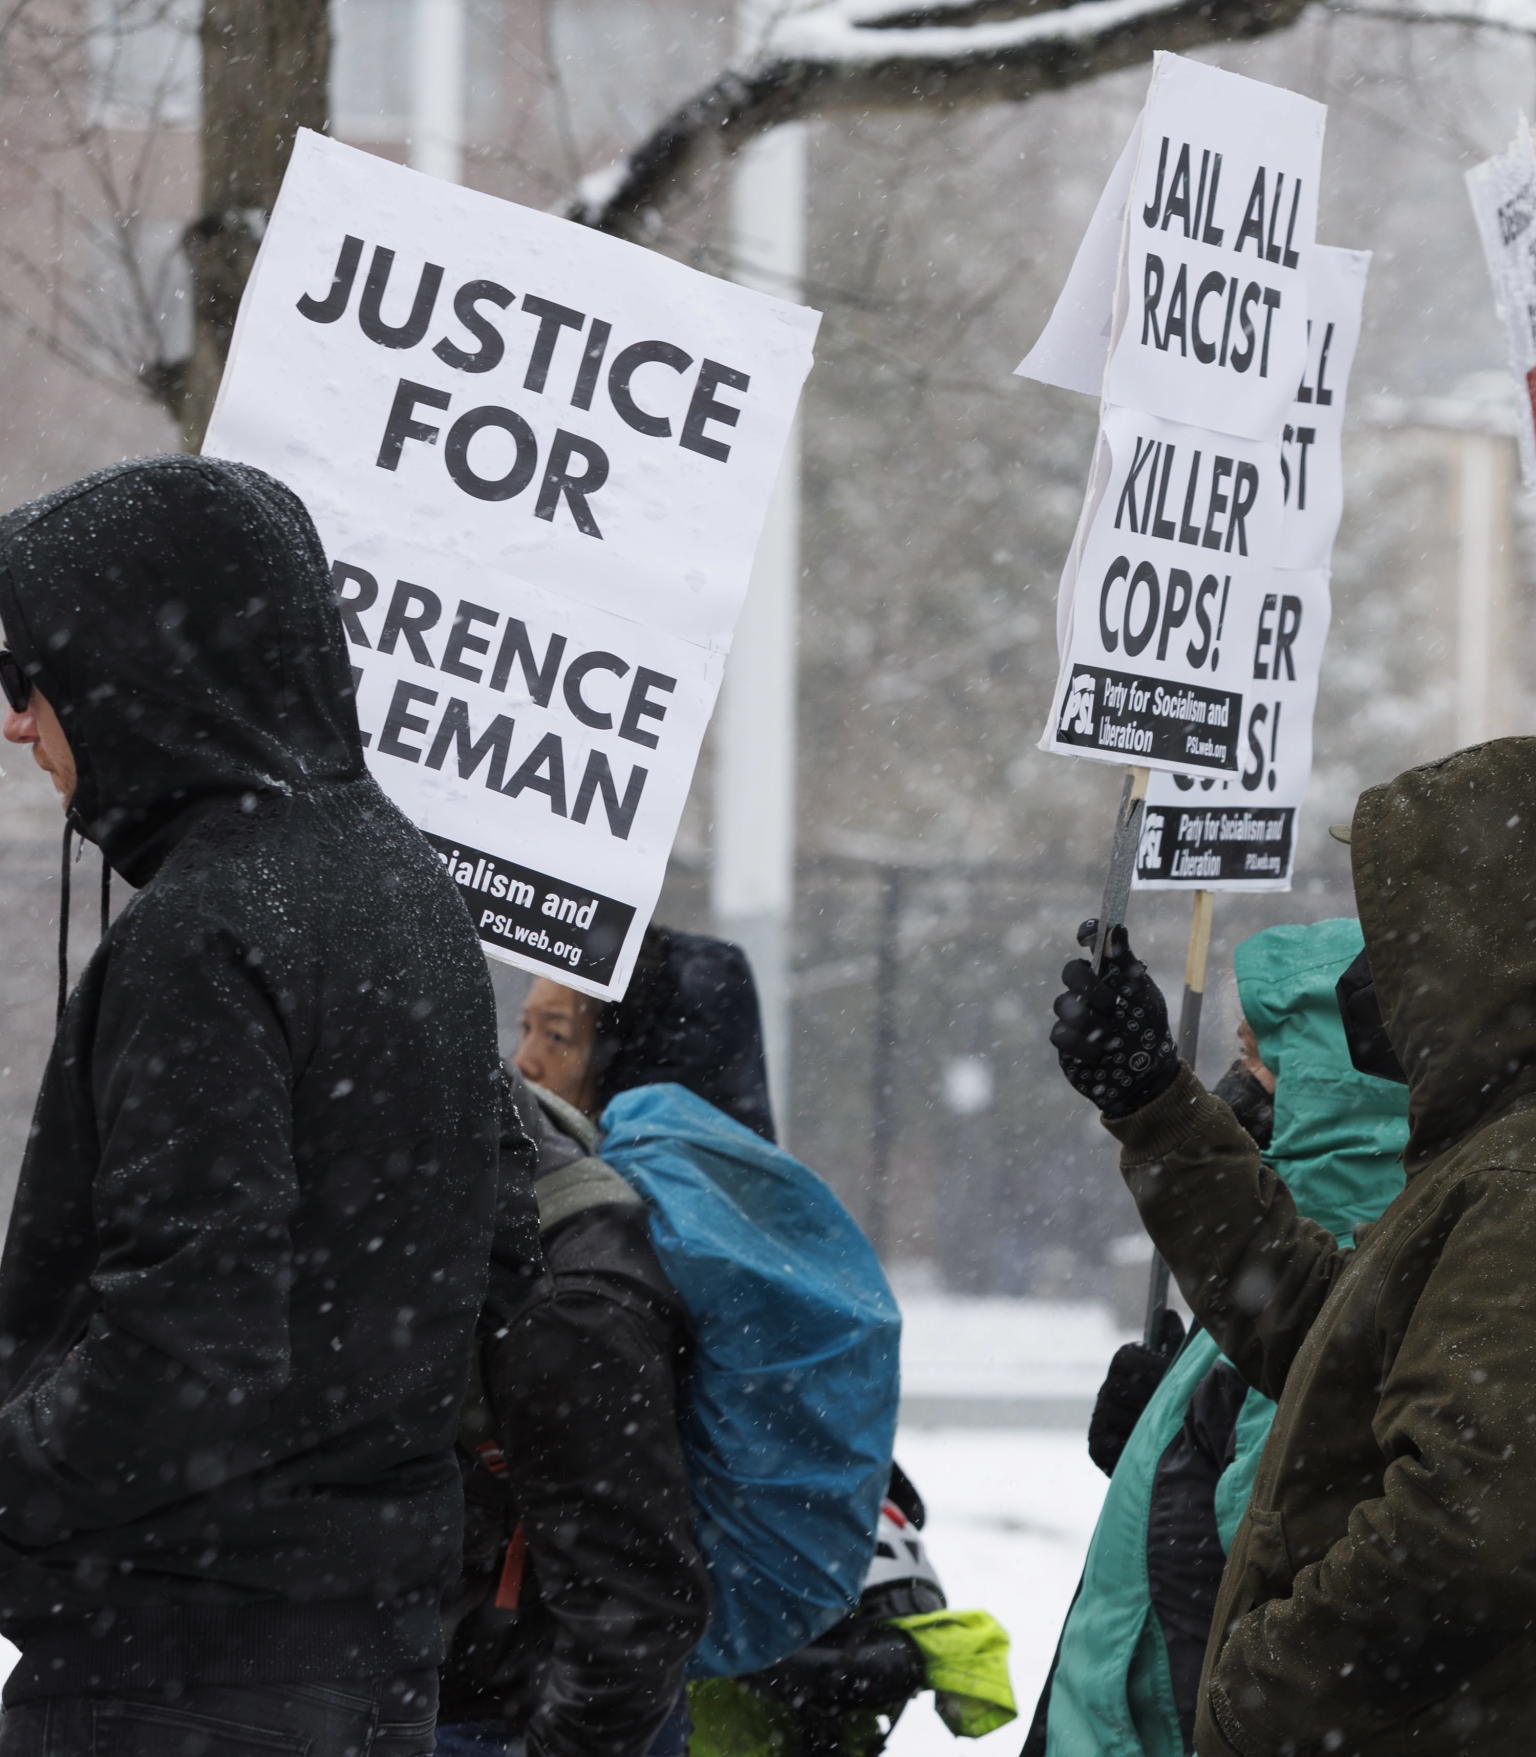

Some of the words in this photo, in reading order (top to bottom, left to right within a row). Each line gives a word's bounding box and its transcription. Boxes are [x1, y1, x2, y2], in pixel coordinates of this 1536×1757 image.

[1143, 136, 1224, 247] JAIL
[1234, 166, 1302, 269] ALL
[296, 234, 751, 463] JUSTICE
[1141, 253, 1281, 378] RACIST
[376, 378, 610, 541] FOR
[1114, 436, 1259, 557] KILLER
[1099, 555, 1231, 672] COPS!
[1098, 716, 1154, 753] Liberation
[1186, 736, 1227, 763] PSLweb.org
[1102, 678, 1127, 716] Party
[1128, 681, 1151, 713] for
[1152, 686, 1206, 724] Socialism
[1207, 698, 1230, 728] and
[1170, 849, 1222, 877] Liberation
[1178, 814, 1203, 847] Party
[1203, 812, 1220, 841] for
[1266, 812, 1286, 842] and
[480, 909, 582, 967] PSLweb.org
[541, 893, 599, 931] and
